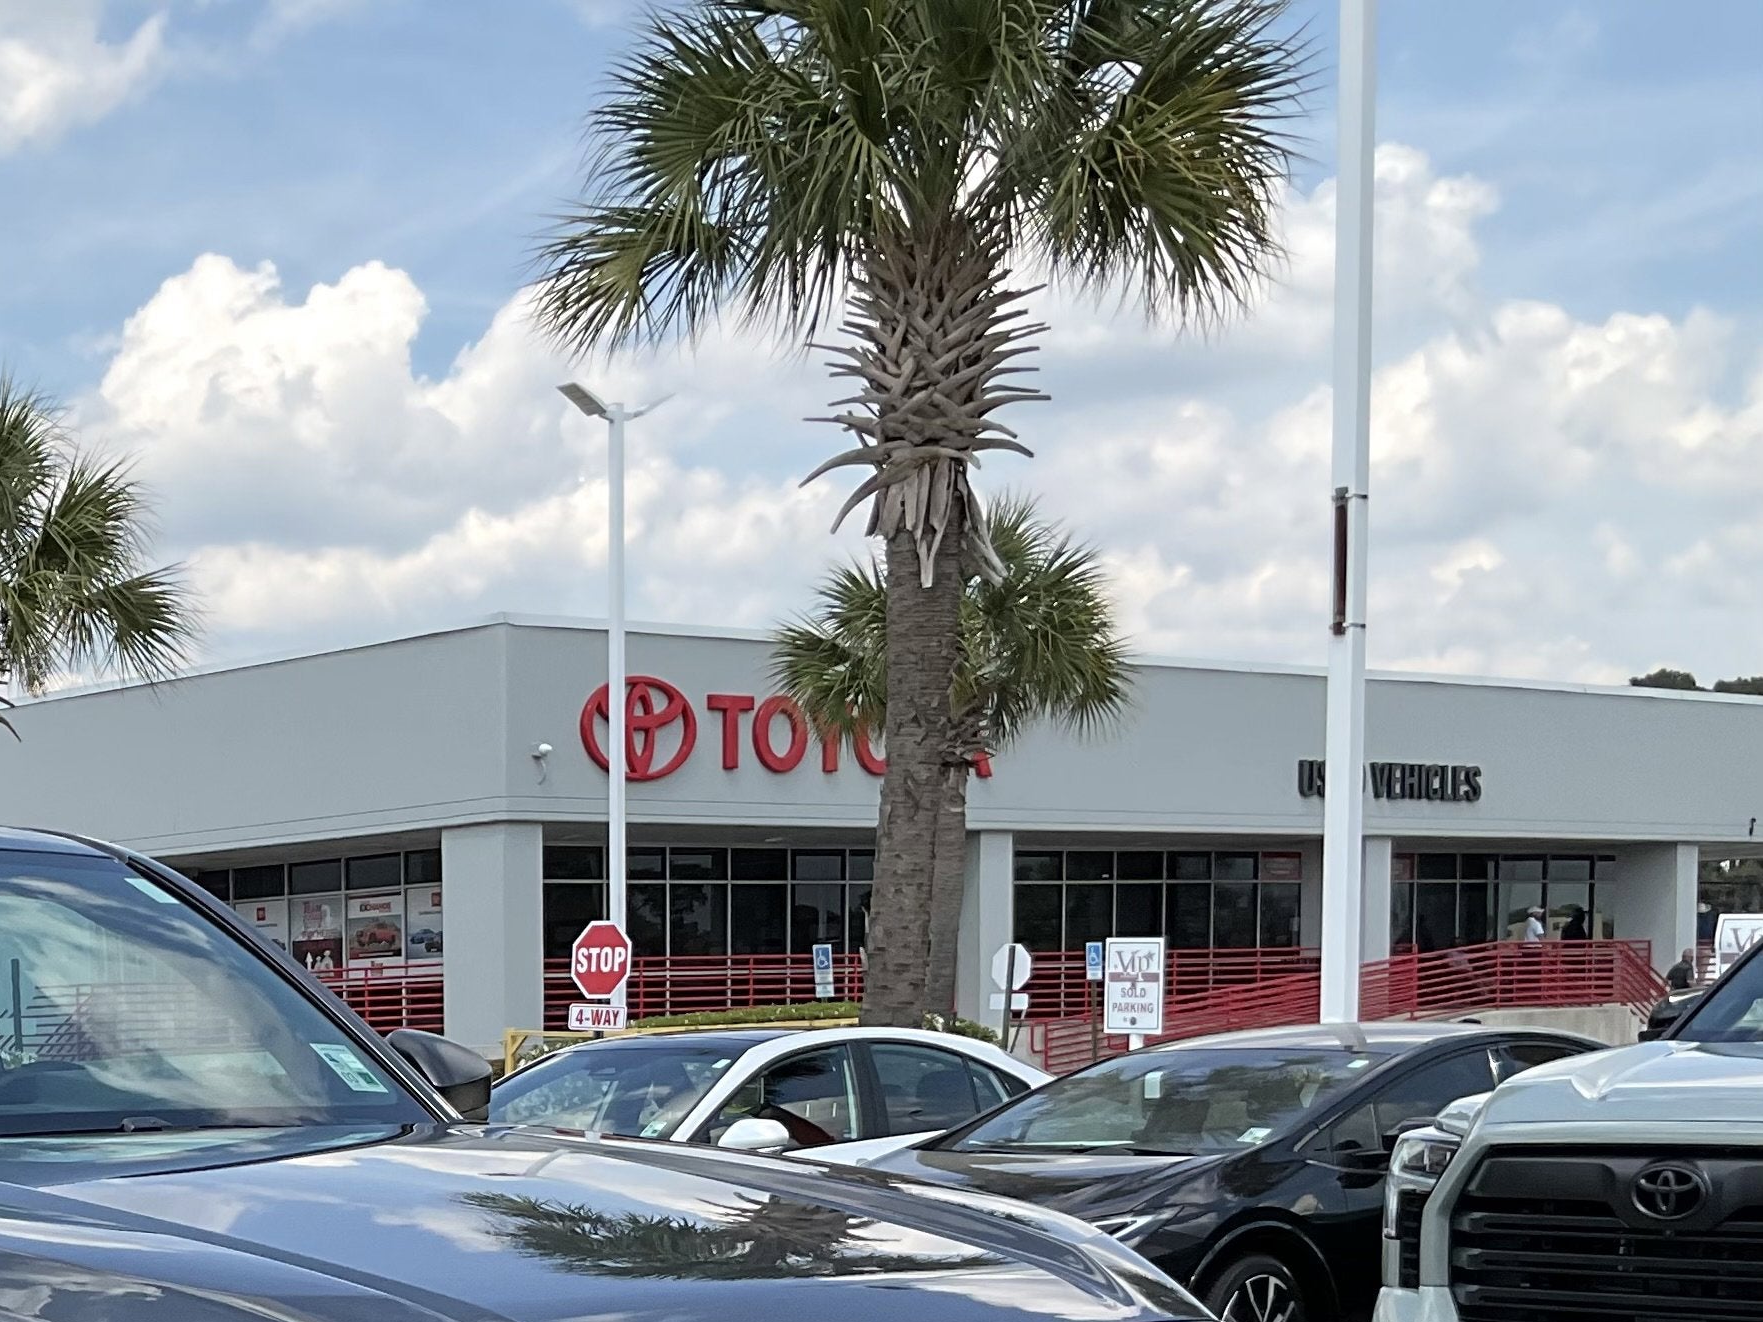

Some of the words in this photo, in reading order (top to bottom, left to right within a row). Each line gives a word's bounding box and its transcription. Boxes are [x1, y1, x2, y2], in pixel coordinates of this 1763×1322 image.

[1369, 762, 1482, 803] VEHICLES
[576, 946, 627, 974] STOP
[1120, 987, 1146, 998] SOLD
[575, 1008, 620, 1027] 4-WAY
[1112, 1002, 1154, 1014] PARKING
